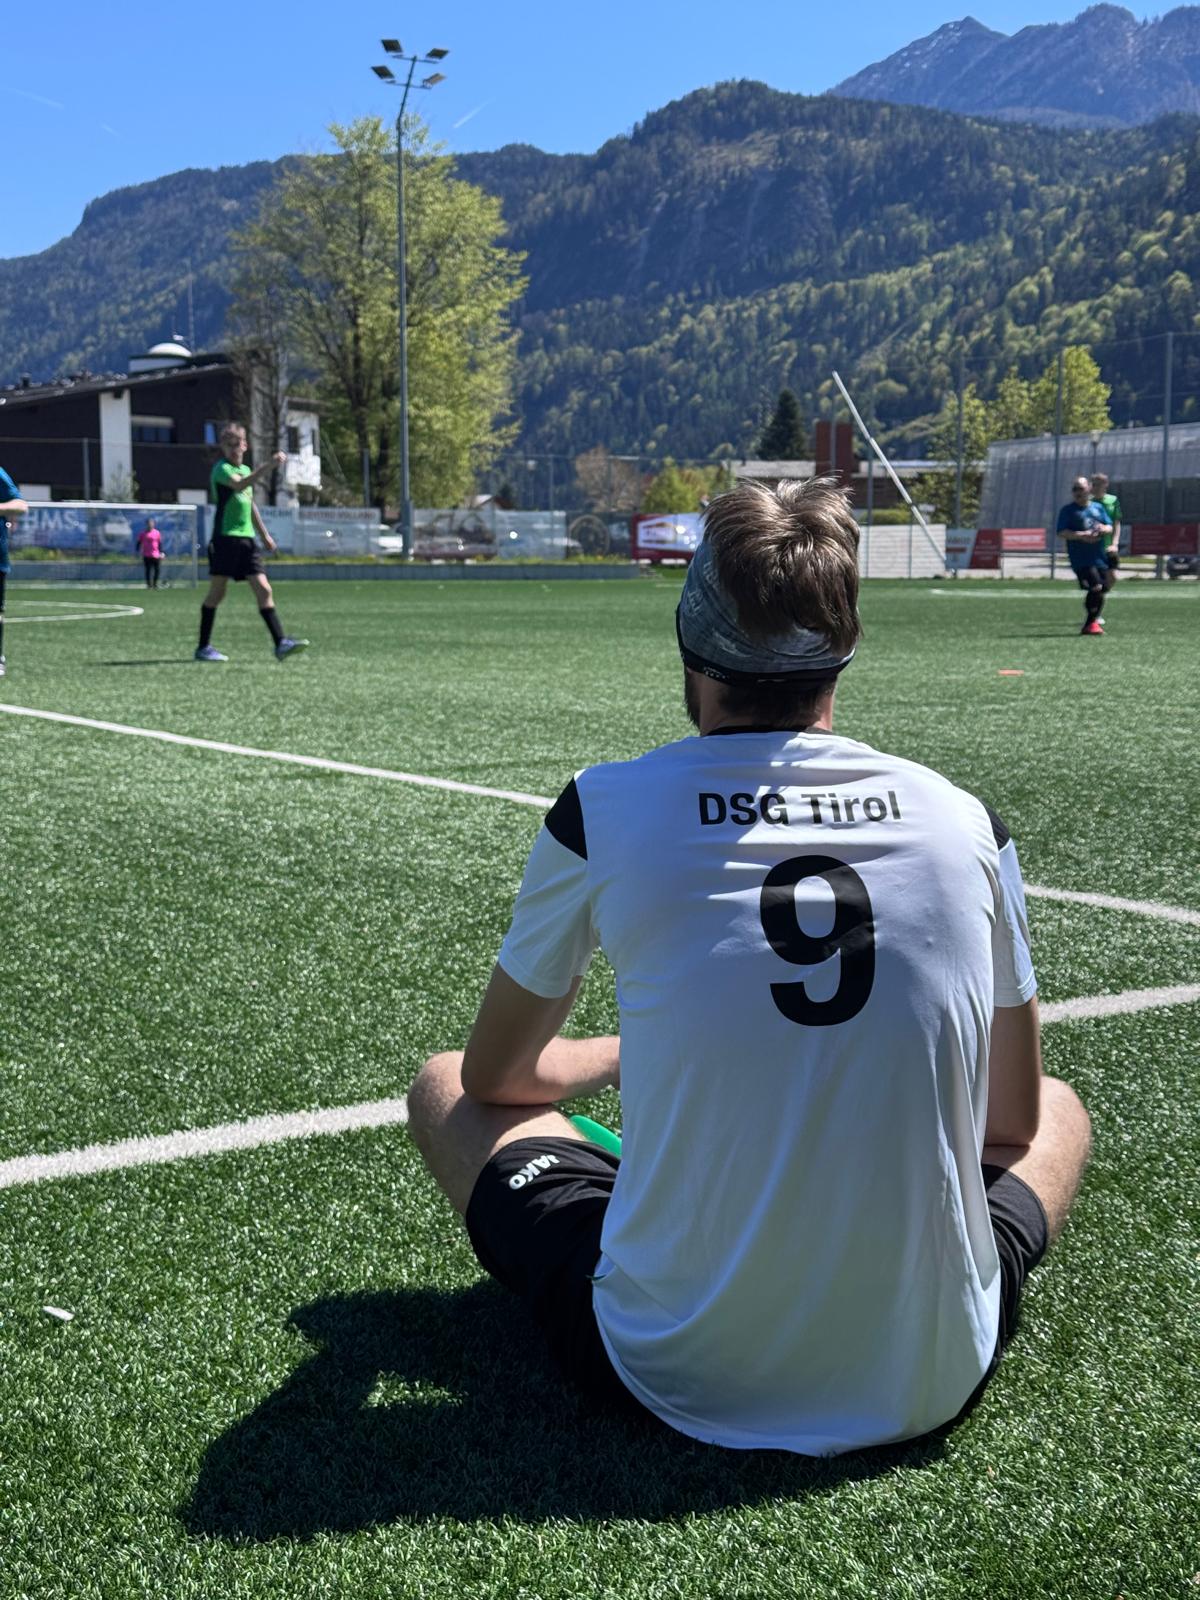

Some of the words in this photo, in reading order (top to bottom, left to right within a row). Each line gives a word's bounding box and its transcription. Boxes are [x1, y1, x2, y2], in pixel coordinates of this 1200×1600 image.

[698, 792, 789, 825] DSG
[801, 790, 902, 823] Tirol
[760, 855, 875, 1026] 9
[509, 1155, 560, 1190] JAKO
